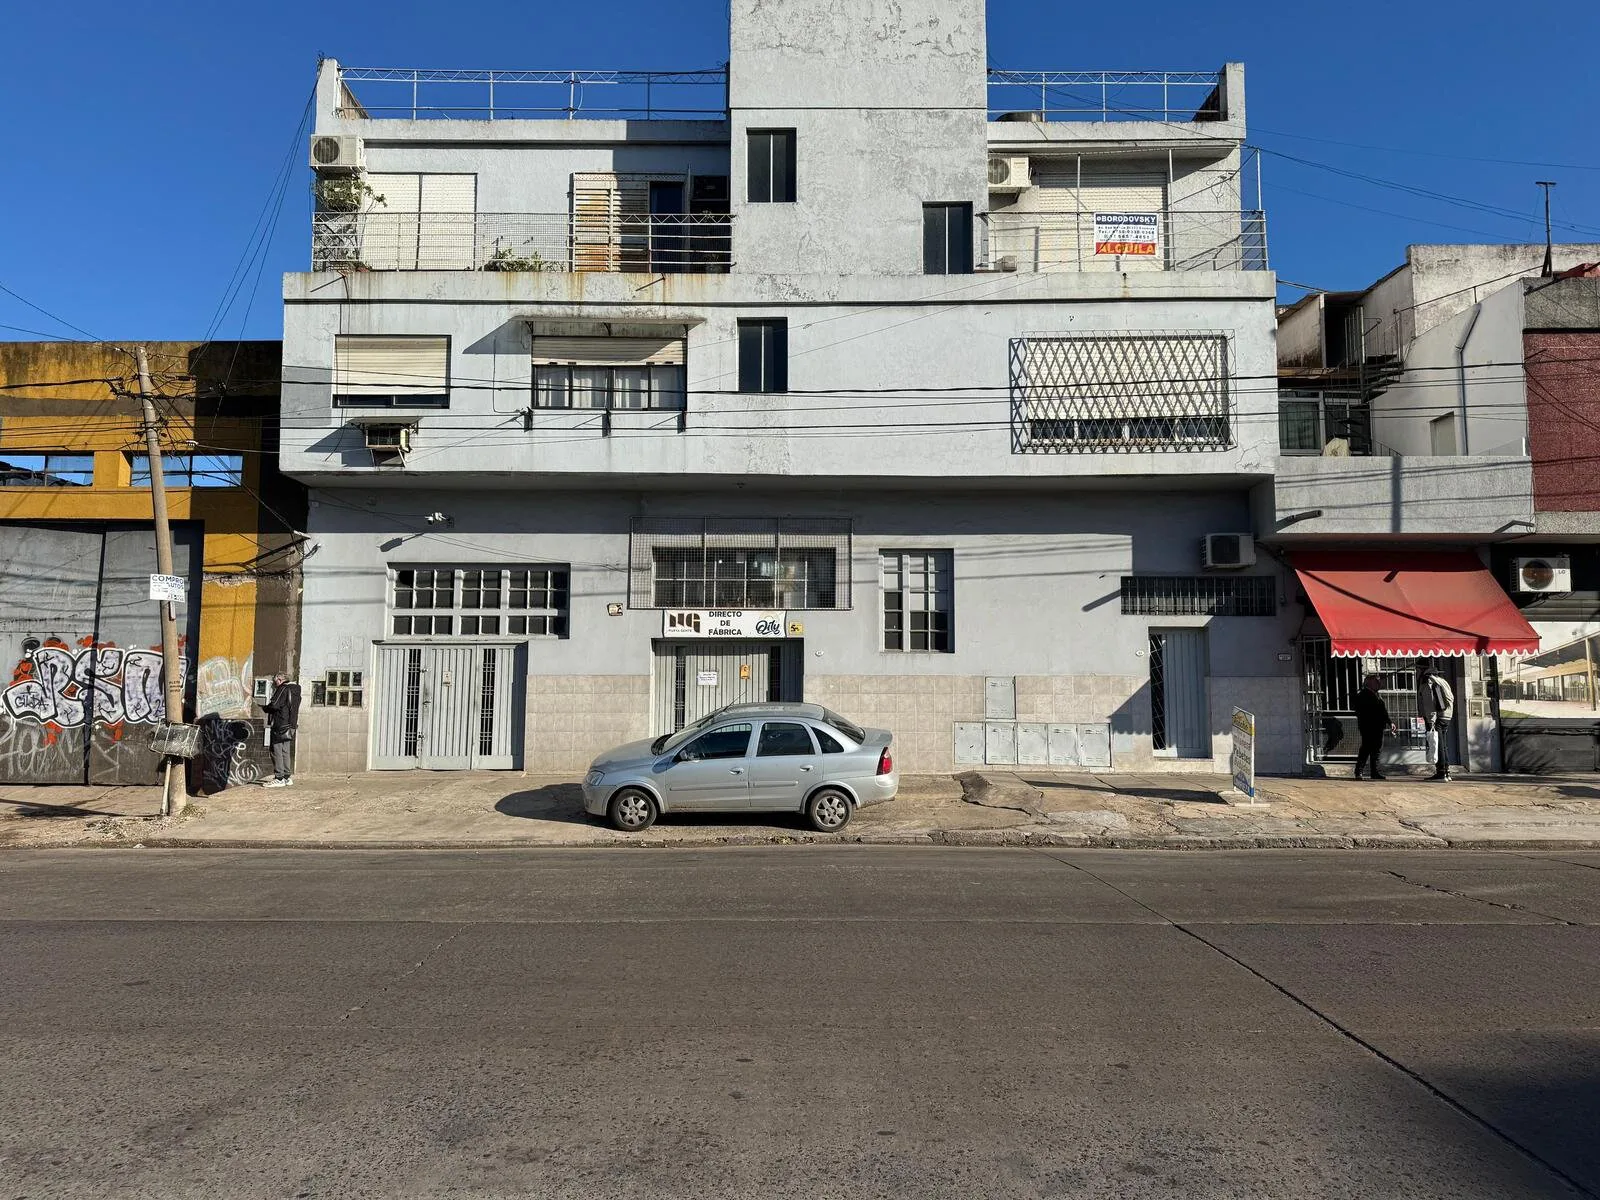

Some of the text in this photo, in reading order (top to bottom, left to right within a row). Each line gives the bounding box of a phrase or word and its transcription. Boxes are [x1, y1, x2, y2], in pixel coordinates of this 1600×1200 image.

[1100, 243, 1154, 254] ALQUILA
[152, 575, 184, 585] COMPRO
[708, 627, 742, 636] FÁBRICA
